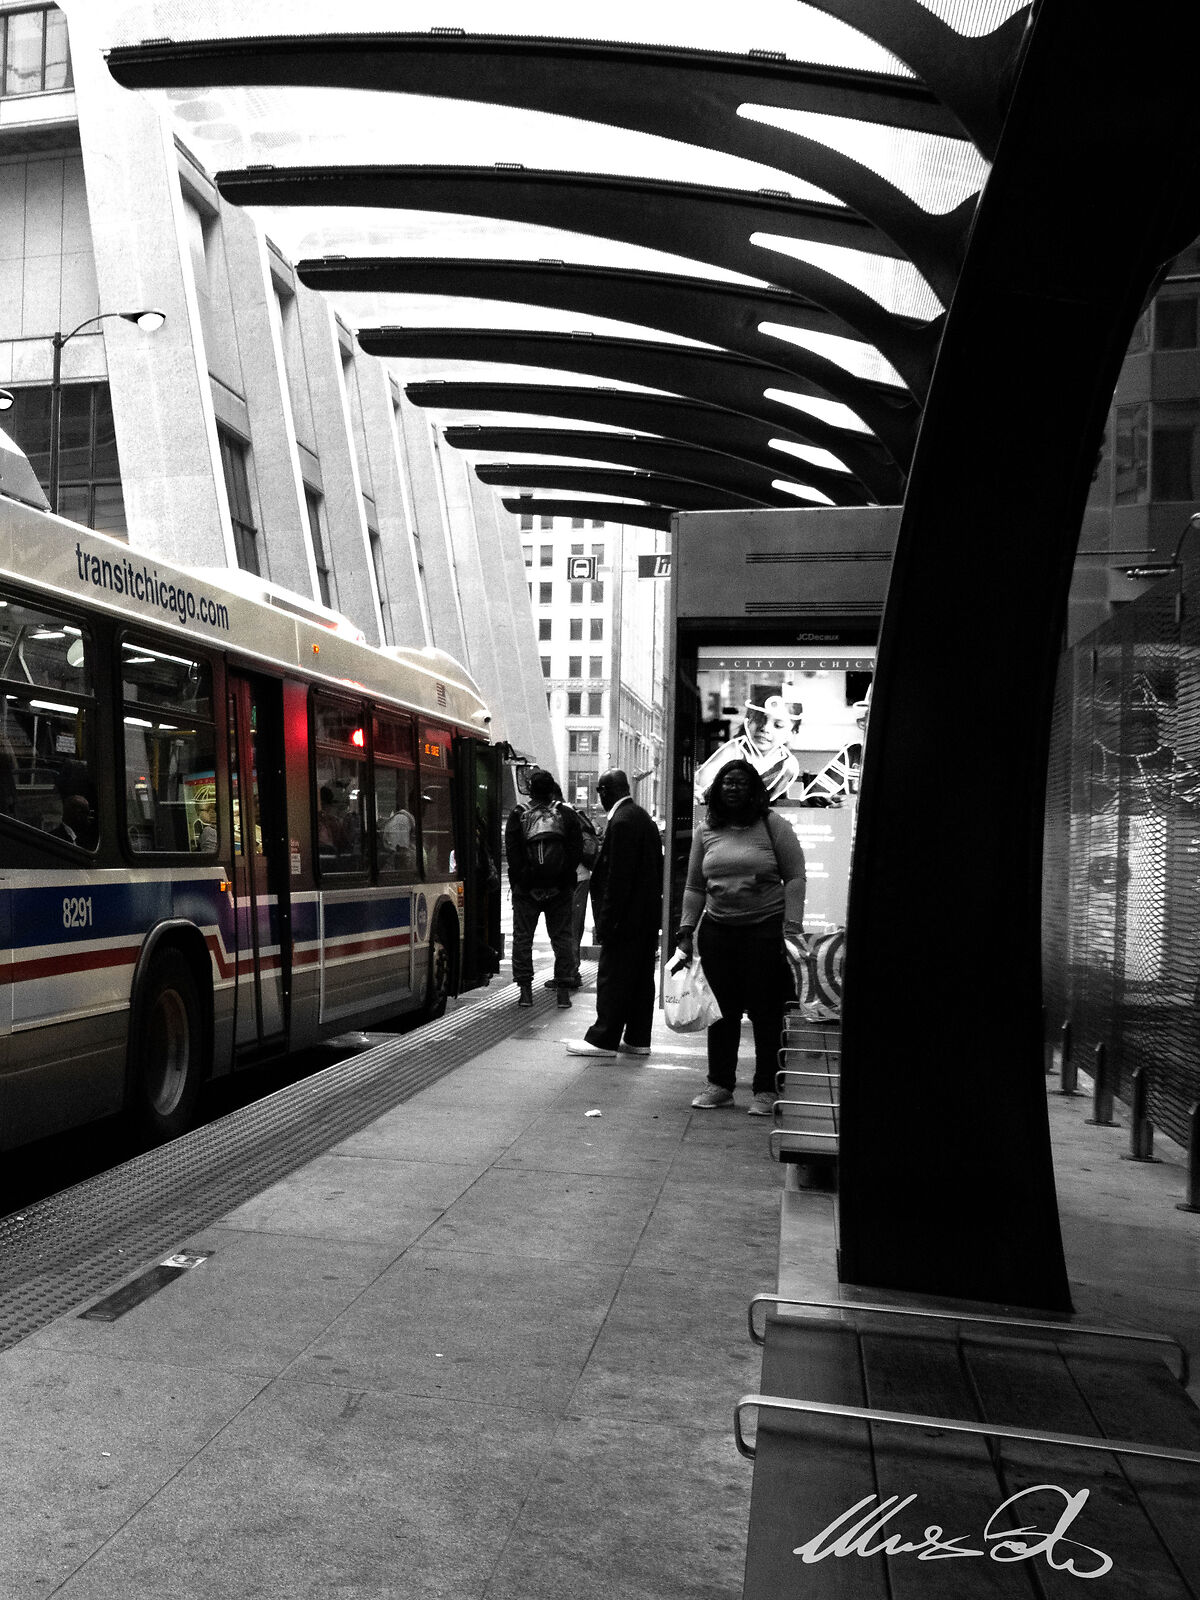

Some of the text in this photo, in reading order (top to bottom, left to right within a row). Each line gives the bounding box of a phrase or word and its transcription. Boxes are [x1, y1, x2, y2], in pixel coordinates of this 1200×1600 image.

[75, 543, 230, 630] transitchicago.com
[797, 633, 840, 641] JCDecaux
[734, 659, 775, 669] CITY
[787, 659, 806, 669] OF
[63, 896, 92, 928] 8291
